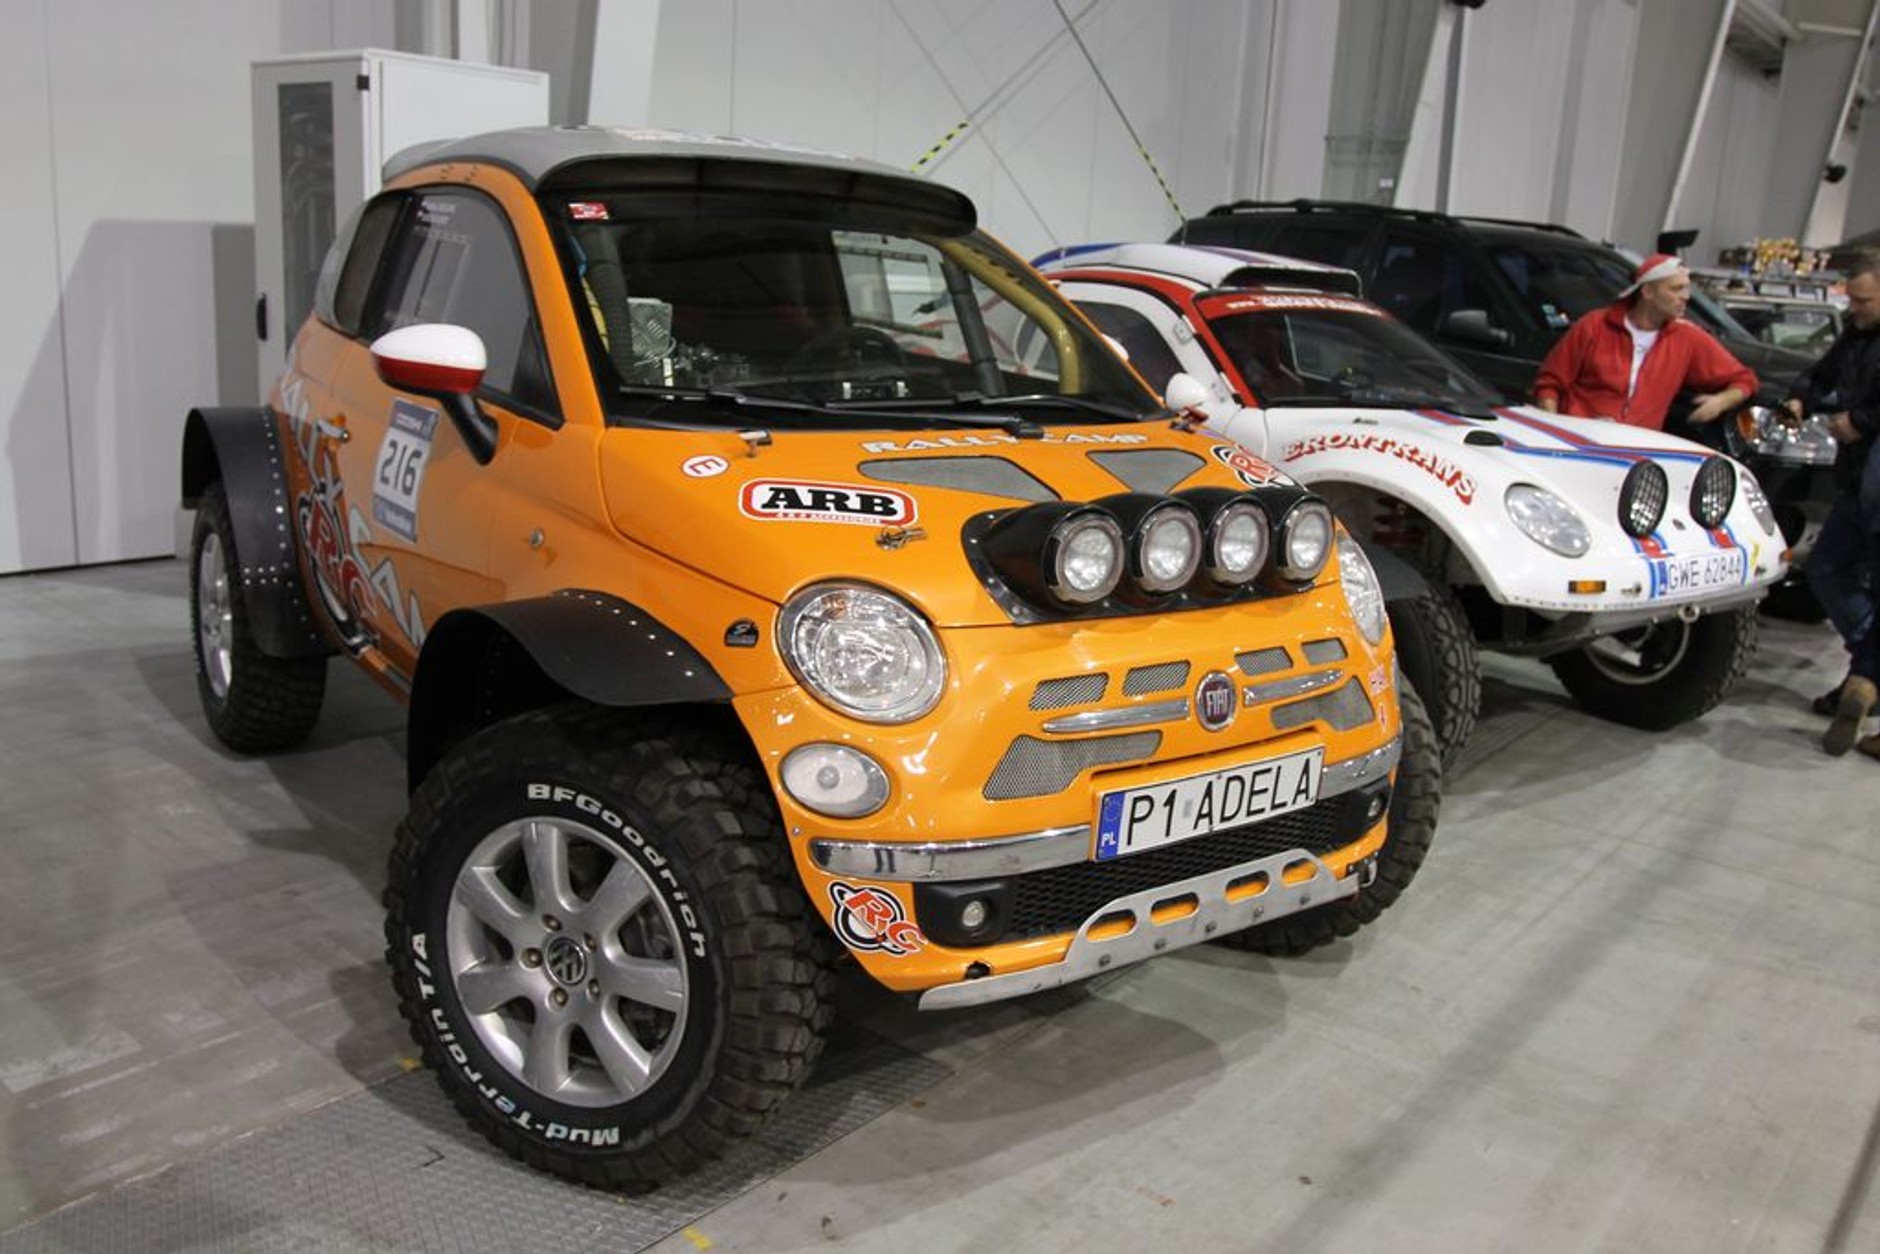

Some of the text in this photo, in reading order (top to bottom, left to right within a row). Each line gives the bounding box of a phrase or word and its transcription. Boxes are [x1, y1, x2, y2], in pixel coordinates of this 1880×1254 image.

[379, 439, 422, 497] 216
[761, 487, 898, 517] ARB
[1668, 554, 1741, 590] GWE 62844
[1205, 686, 1230, 718] FIAT
[1126, 757, 1311, 847] P1 ADELA
[1100, 832, 1117, 848] PL
[527, 783, 706, 958] BFGoodrich
[411, 932, 620, 1147] Mud-Terrain T/A
